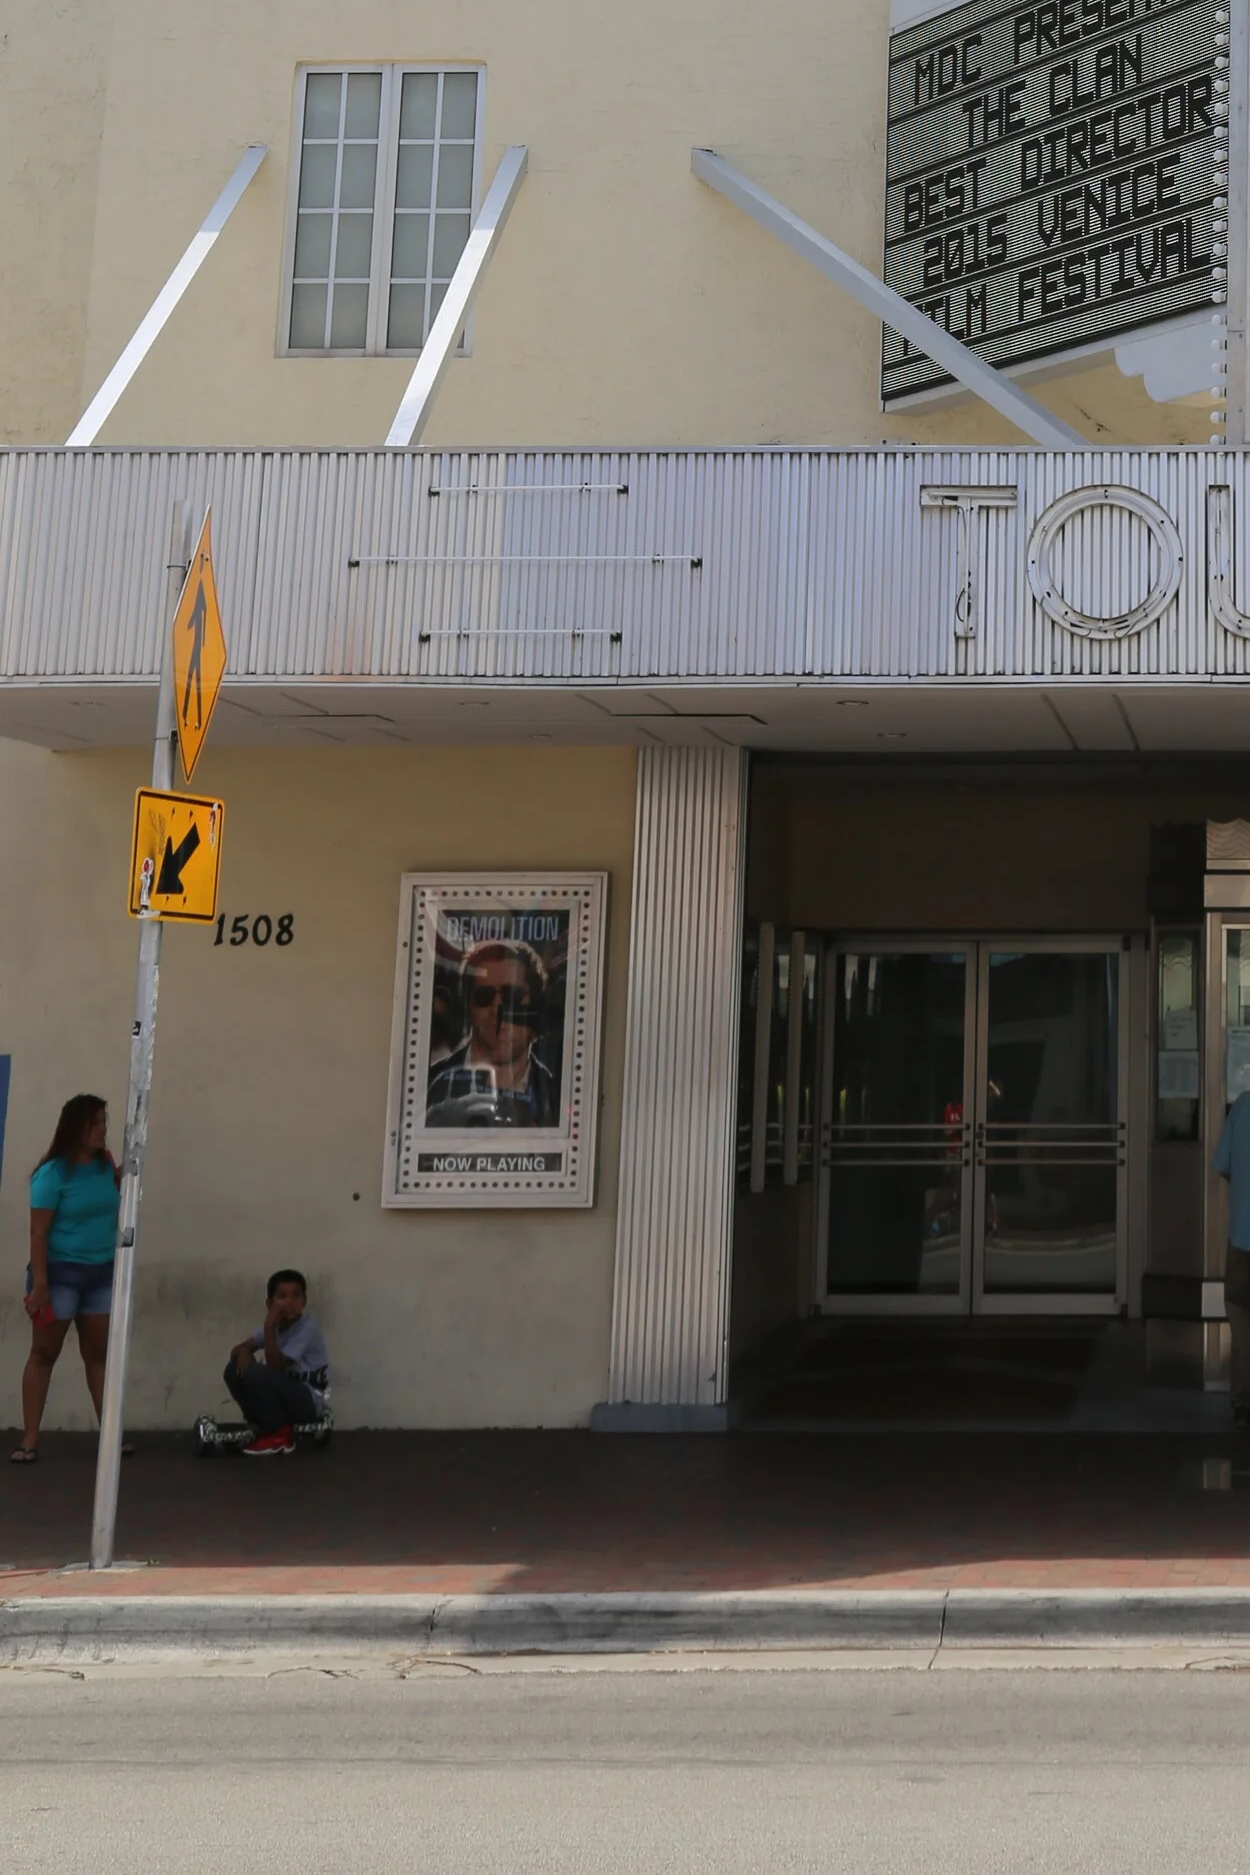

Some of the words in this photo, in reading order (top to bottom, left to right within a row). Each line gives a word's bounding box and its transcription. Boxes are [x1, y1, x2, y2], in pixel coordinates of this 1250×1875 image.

[914, 33, 982, 106] MDC
[962, 78, 1026, 148] THE
[1049, 34, 1142, 118] CLAN
[903, 157, 987, 235] BEST
[1020, 74, 1212, 191] DIRECTOR
[922, 213, 1008, 288] 2015
[1037, 152, 1182, 249] VENICE
[1018, 217, 1211, 323] FESTIVAL
[213, 913, 295, 946] 1508
[447, 916, 559, 941] DEMOLITION
[433, 1157, 472, 1171] NOW
[476, 1156, 545, 1171] PLAYING
